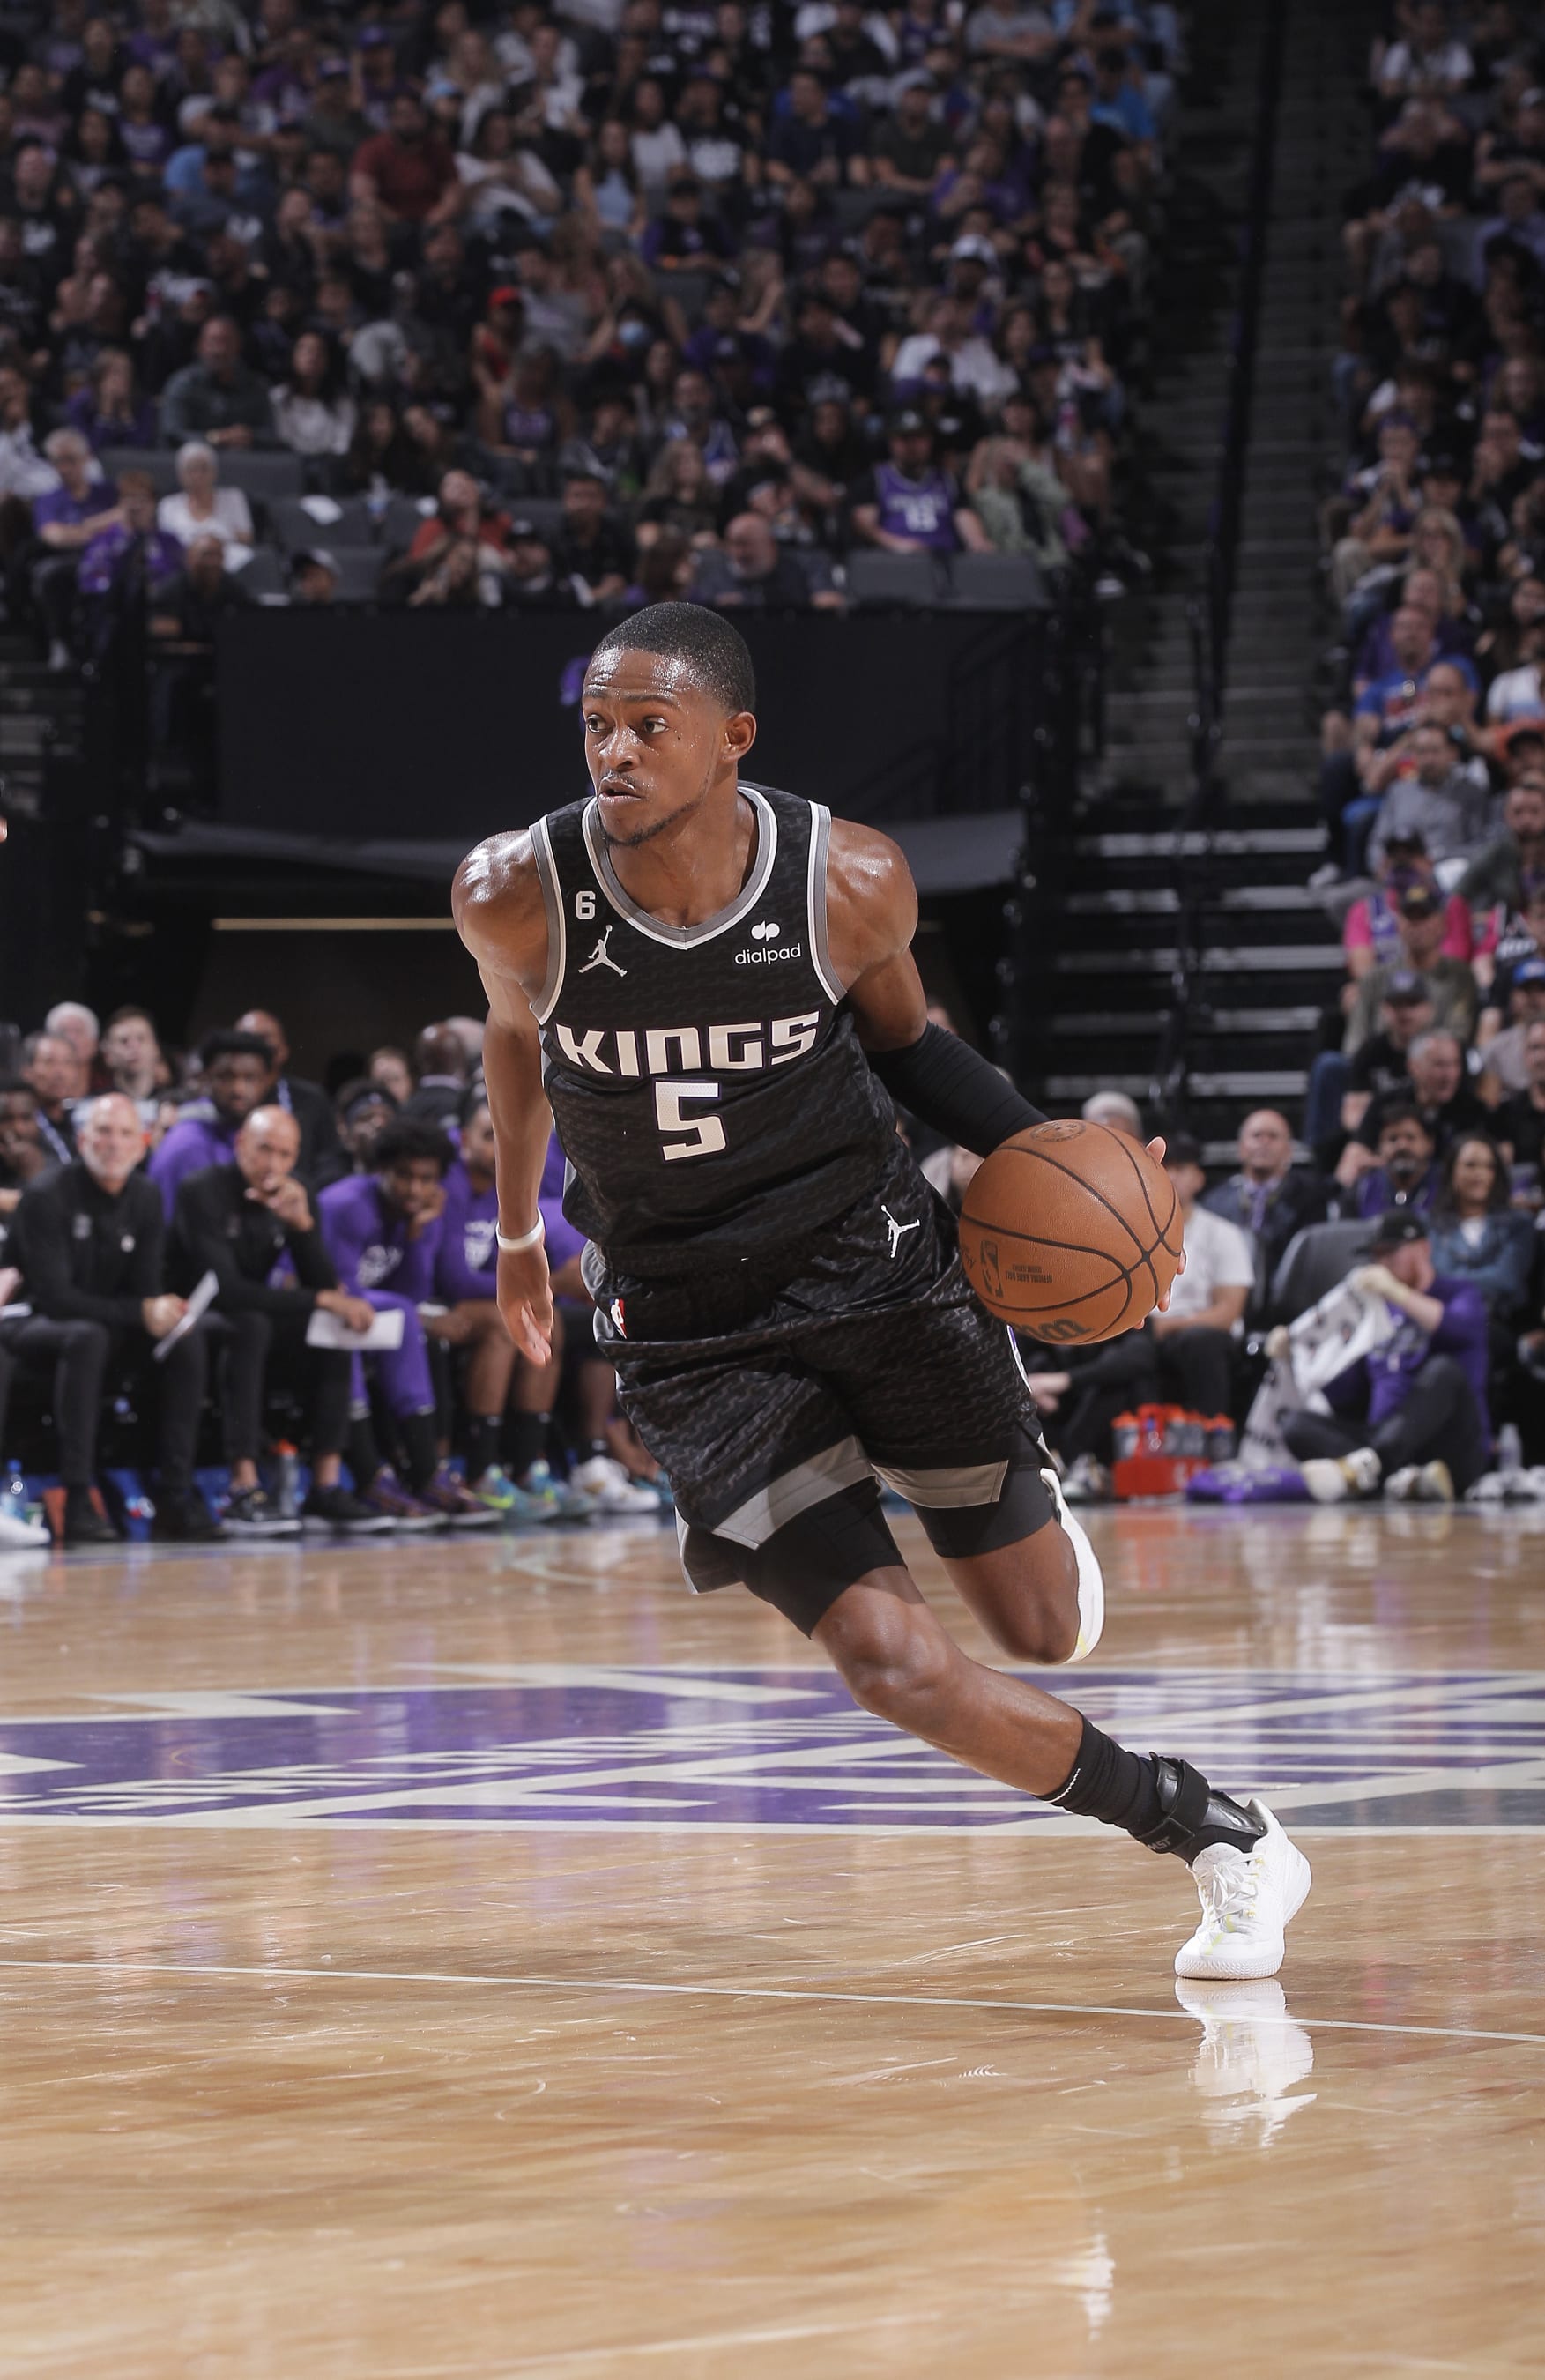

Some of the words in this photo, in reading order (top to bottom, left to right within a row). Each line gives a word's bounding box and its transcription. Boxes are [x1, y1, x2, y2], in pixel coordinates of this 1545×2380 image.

[576, 890, 596, 919] 6
[734, 942, 801, 965] dialpad
[555, 1010, 821, 1077] KINGS
[655, 1081, 726, 1161] 5
